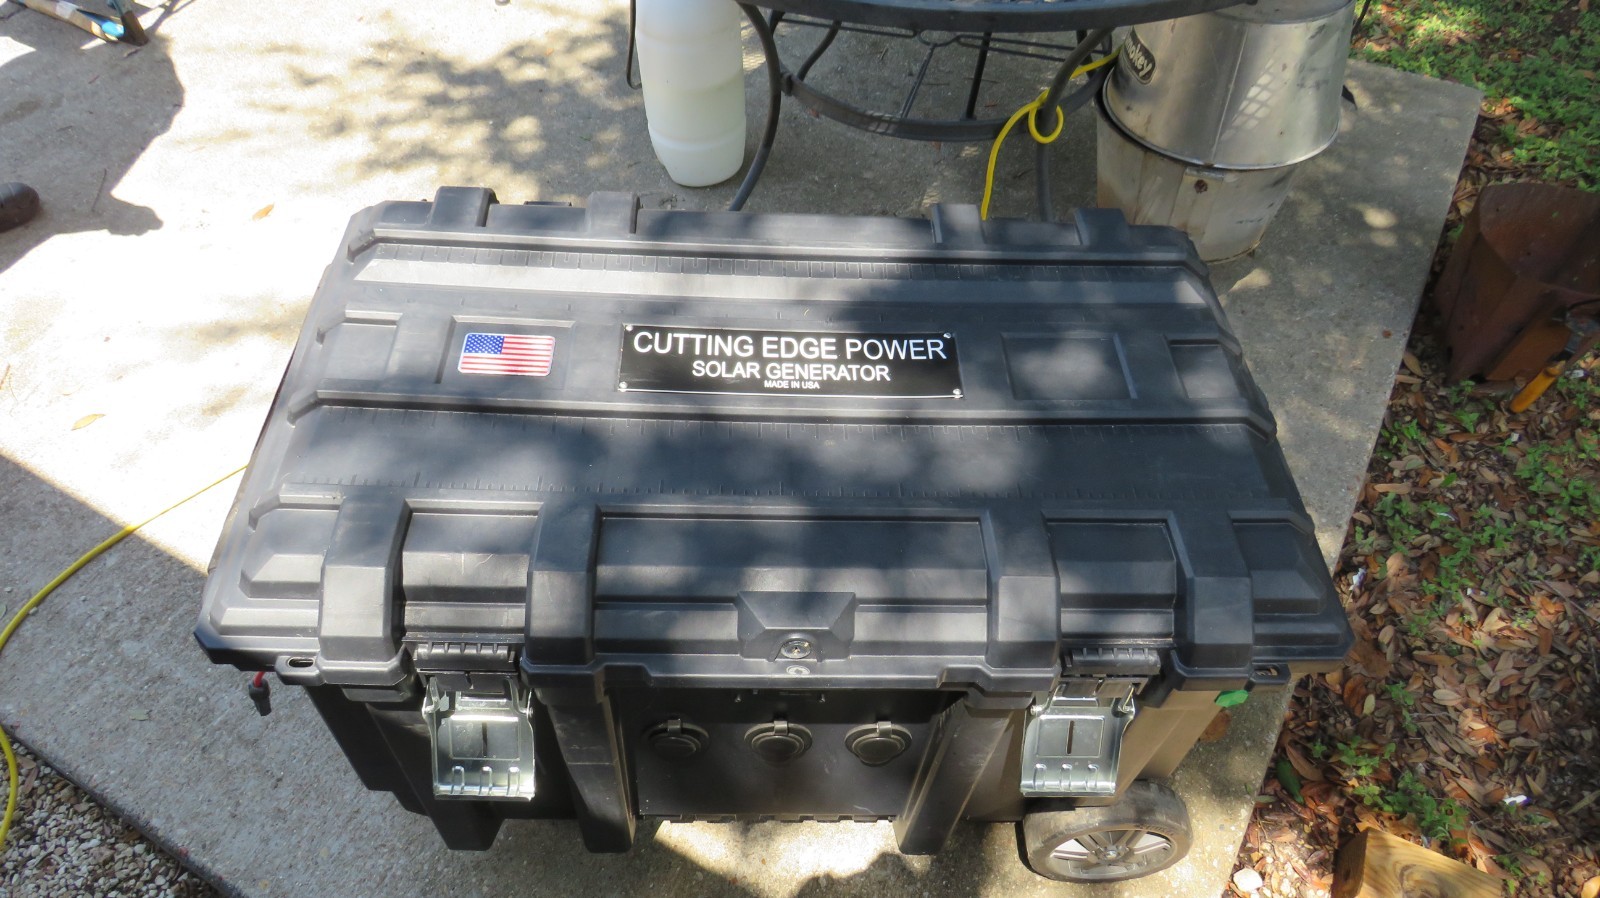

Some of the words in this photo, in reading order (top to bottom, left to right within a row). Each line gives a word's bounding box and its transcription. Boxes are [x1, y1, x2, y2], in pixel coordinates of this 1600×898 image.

[1125, 37, 1153, 78] mokey
[633, 331, 754, 357] CUTTING
[762, 336, 838, 359] EDGE
[845, 339, 947, 360] POWER
[692, 360, 760, 379] SOLAR
[766, 363, 891, 382] GENERATOR
[764, 380, 789, 389] MADE
[791, 381, 800, 389] IN
[802, 381, 819, 390] USA
